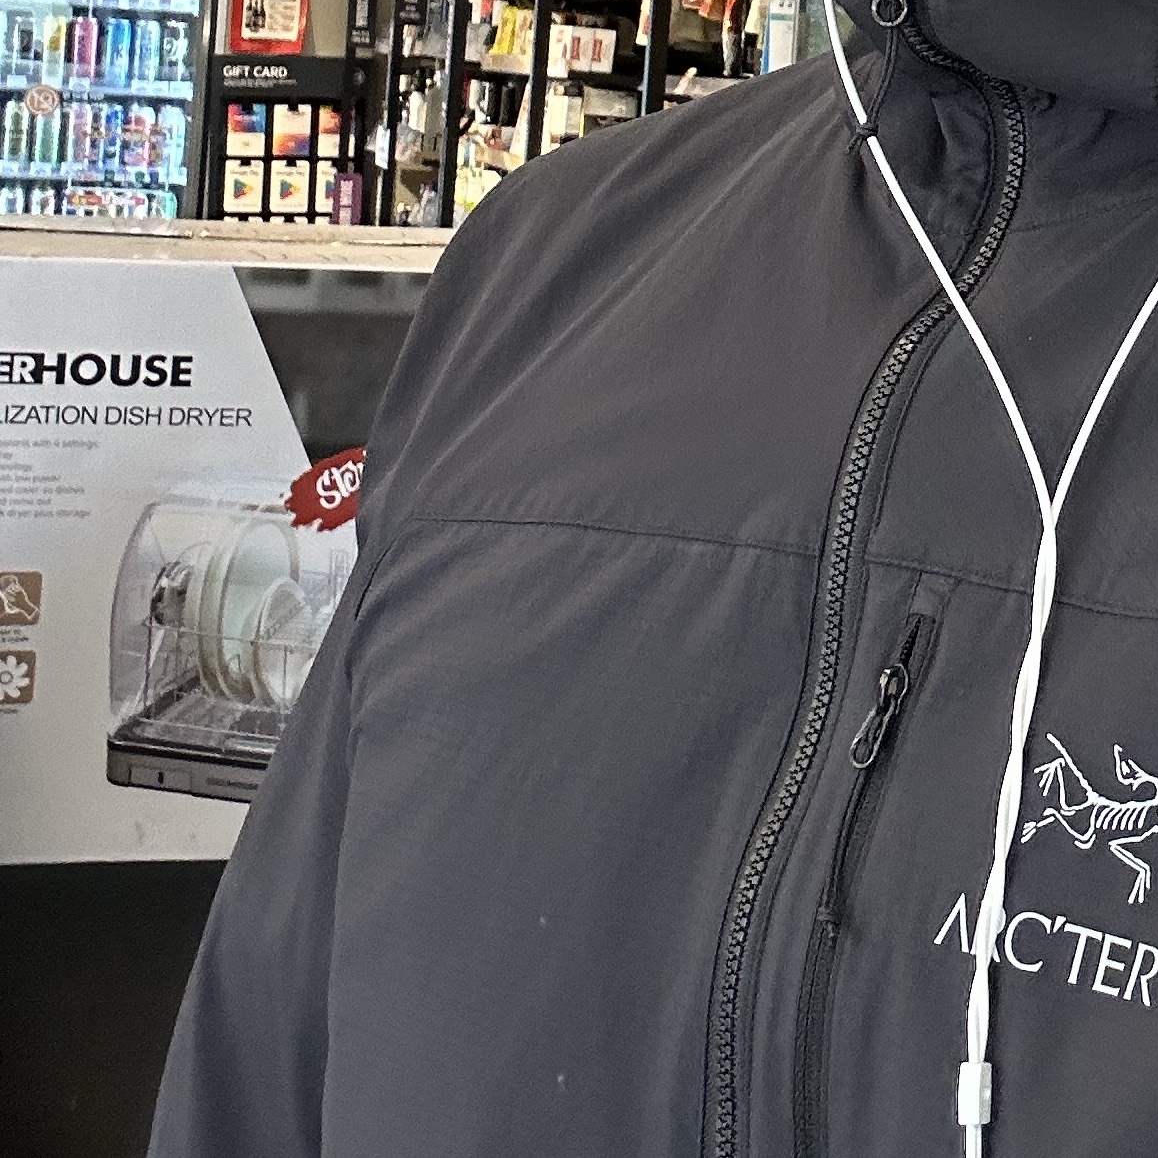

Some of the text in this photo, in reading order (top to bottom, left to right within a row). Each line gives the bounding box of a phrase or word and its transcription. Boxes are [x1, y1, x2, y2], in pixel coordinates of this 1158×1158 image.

[223, 65, 288, 78] GIFT CARD
[0, 405, 252, 428] IZATION DISH DRYER
